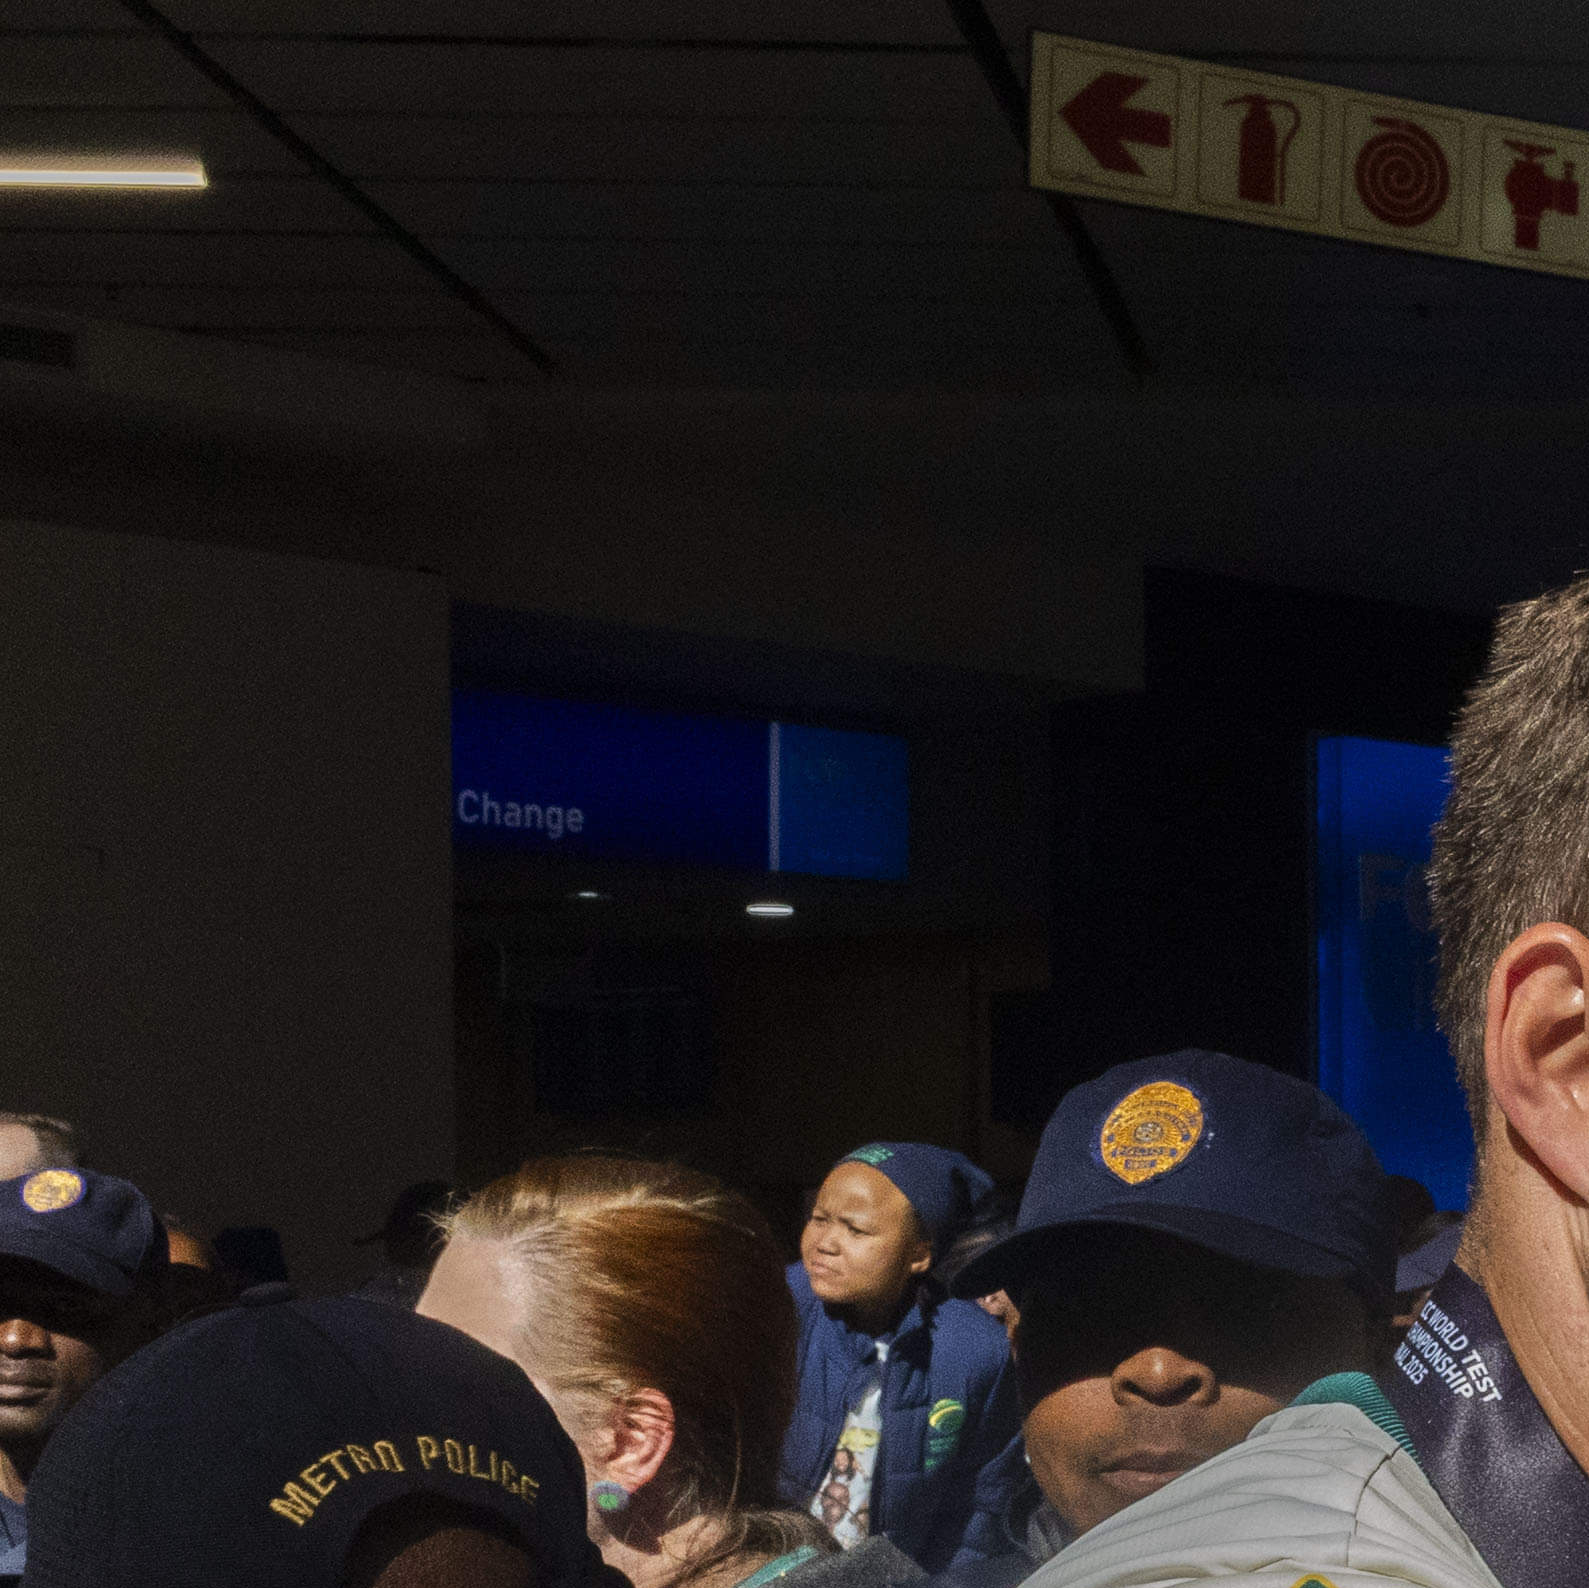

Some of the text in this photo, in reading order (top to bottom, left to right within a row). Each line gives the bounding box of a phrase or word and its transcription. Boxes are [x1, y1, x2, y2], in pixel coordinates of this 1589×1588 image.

[457, 789, 585, 840] Change
[1402, 1354, 1430, 1385] 2025
[1427, 1306, 1469, 1352] WORLD
[1461, 1349, 1503, 1402] TEST
[269, 1435, 540, 1527] METRO POLICE
